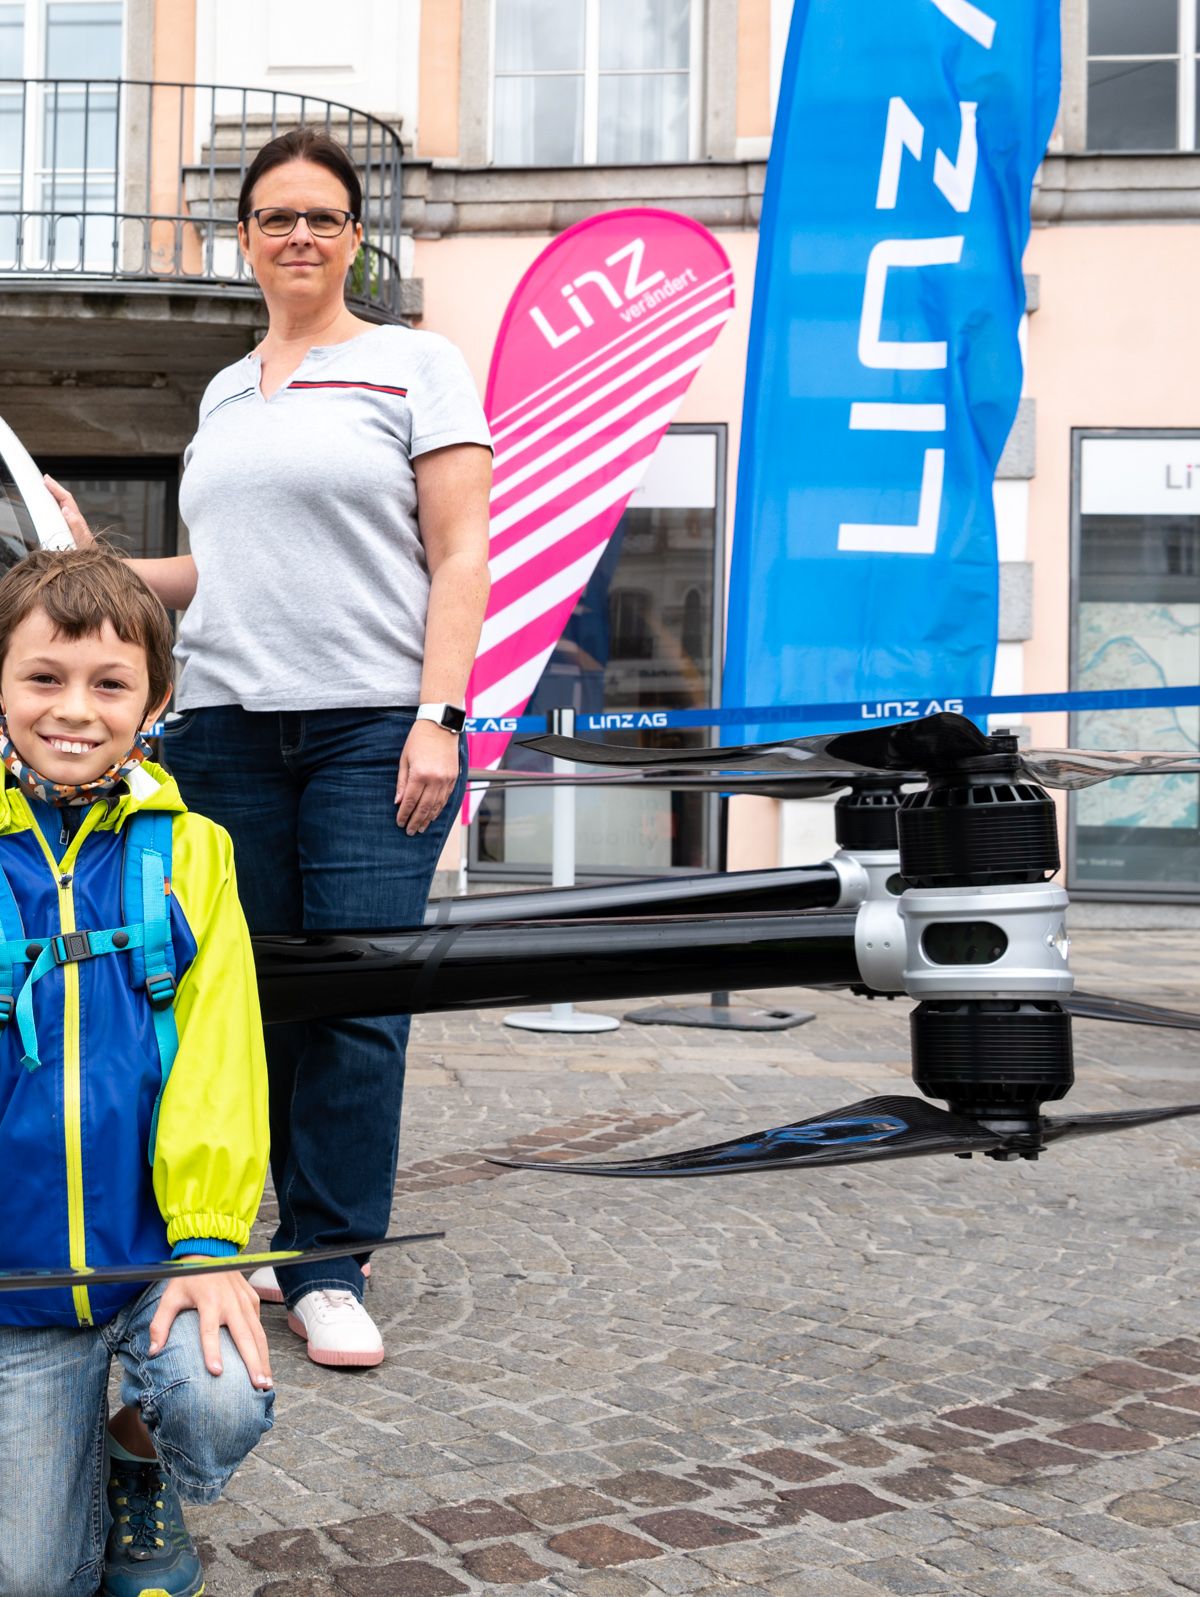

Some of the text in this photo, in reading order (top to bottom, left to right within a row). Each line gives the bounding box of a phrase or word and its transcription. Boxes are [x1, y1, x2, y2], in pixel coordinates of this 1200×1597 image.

[619, 268, 698, 323] verändert
[837, 96, 978, 555] LINZ
[861, 699, 963, 719] LINZ AG
[481, 718, 517, 732] AG
[589, 713, 668, 729] LINZ AG
